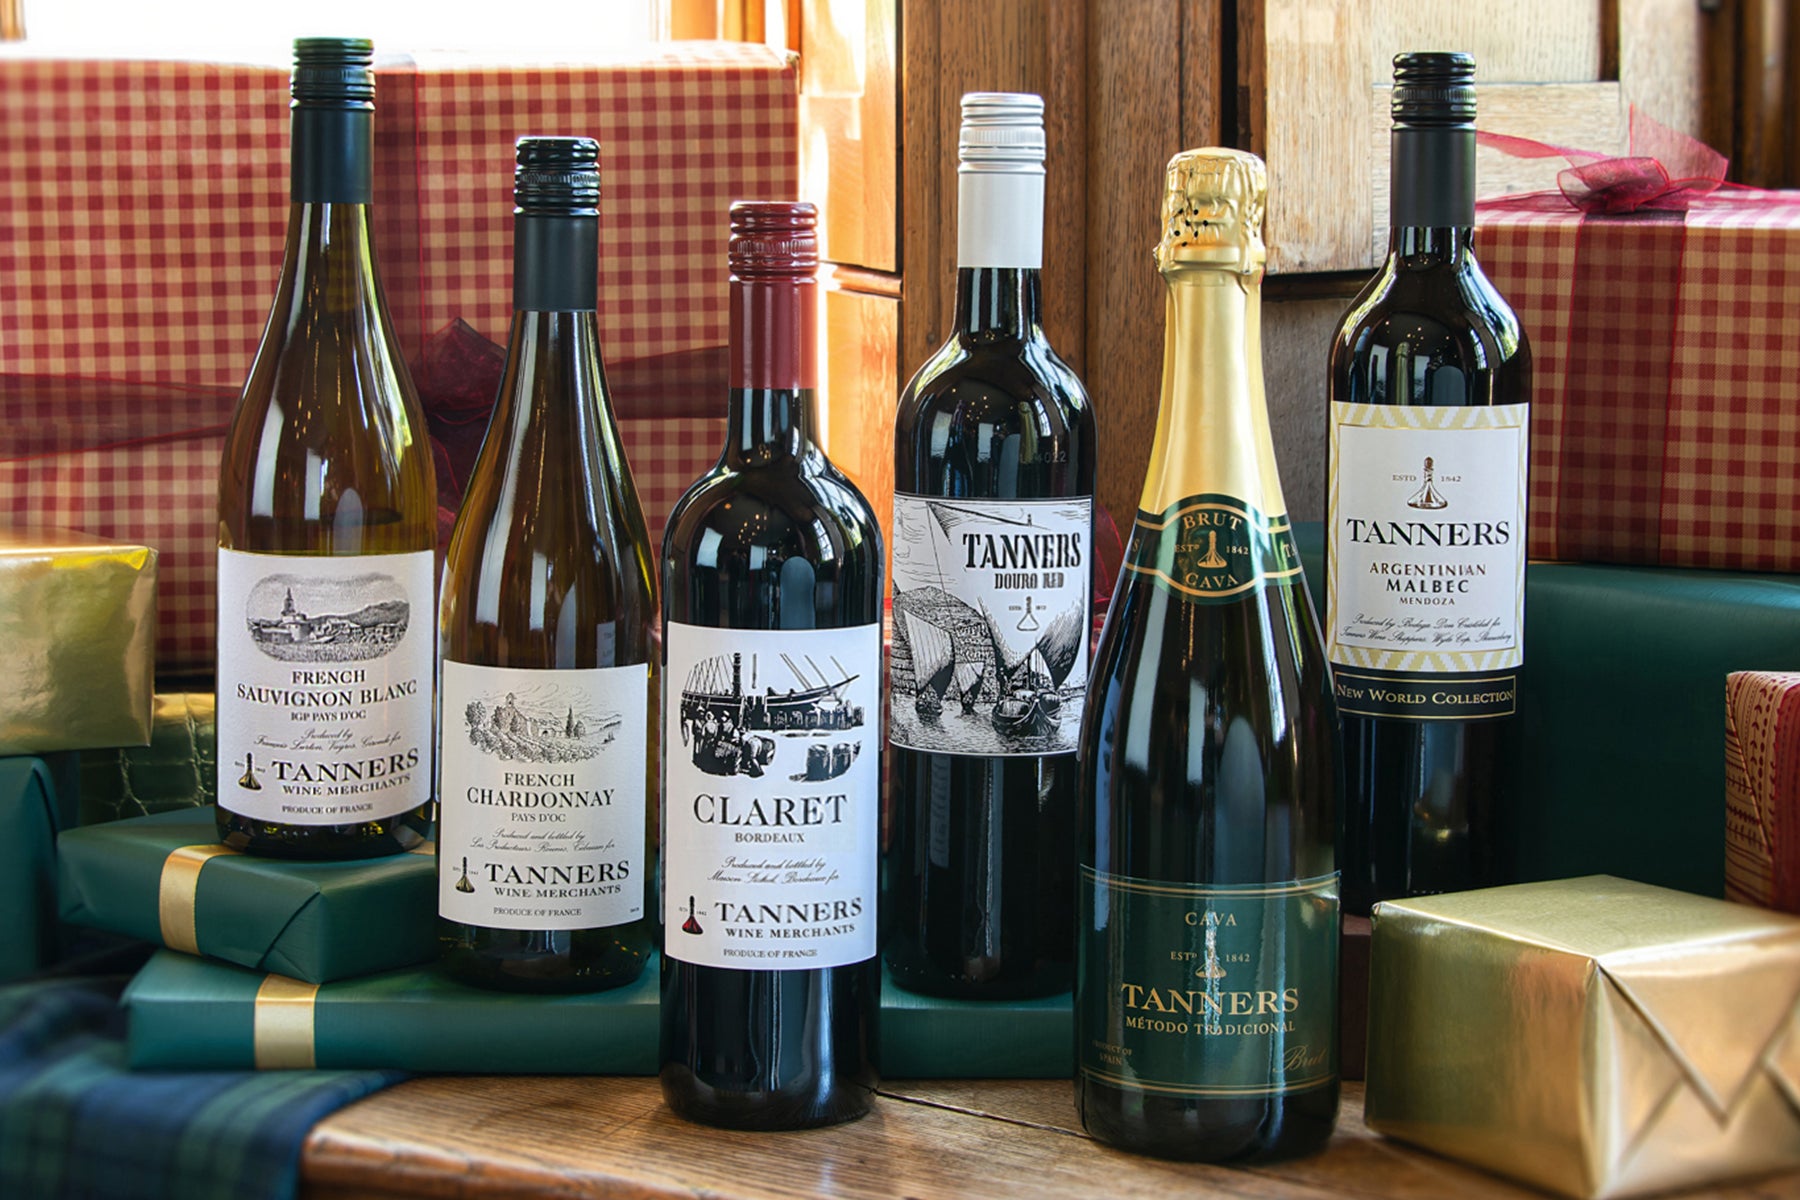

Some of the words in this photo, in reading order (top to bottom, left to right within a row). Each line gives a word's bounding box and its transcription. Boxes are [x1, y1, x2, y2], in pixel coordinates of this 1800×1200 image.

[1441, 475, 1462, 483] 1842
[1182, 512, 1242, 531] BRUT
[1346, 518, 1510, 547] TANNERS
[962, 532, 1081, 569] TANNERS
[1226, 545, 1249, 555] 1842
[1370, 562, 1486, 576] ARGENTINIAN
[994, 573, 1038, 590] DOURO
[1042, 572, 1064, 589] RED
[1185, 572, 1239, 589] CAVA
[1386, 578, 1469, 594] MALBEC
[1400, 597, 1455, 606] MENDOZA
[1352, 613, 1387, 626] Produced
[292, 670, 366, 685] FRENCH
[237, 683, 352, 707] SAUVIGNON
[360, 679, 418, 705] BLANC
[290, 711, 310, 722] IGP
[312, 712, 338, 722] PAYS
[300, 728, 344, 740] Produced
[271, 748, 419, 782] TANNERS
[282, 784, 322, 796] WINE
[328, 774, 411, 796] MERCHANTS
[504, 772, 575, 787] FRENCH
[466, 786, 615, 808] CHARDONNAY
[282, 804, 322, 814] PRODUCE
[325, 805, 338, 814] OF
[340, 803, 374, 814] FRANCE
[693, 794, 848, 826] CLARET
[511, 812, 536, 822] PAYS
[492, 827, 531, 839] Produced
[530, 831, 550, 840] and
[735, 832, 805, 844] BORDEAUX
[720, 856, 767, 868] Produced
[765, 859, 788, 869] and
[785, 859, 817, 869] bottled
[815, 858, 826, 872] by
[484, 860, 630, 884] TANNERS
[494, 887, 532, 898] WINE
[536, 884, 622, 898] MERCHANTS
[493, 906, 532, 916] PRODUCE
[534, 908, 546, 916] OF
[548, 908, 582, 916] FRANCE
[714, 897, 862, 924] TANNERS
[1184, 912, 1238, 927] CAVA
[726, 928, 764, 938] WINE
[770, 924, 855, 938] MERCHANTS
[724, 948, 766, 958] PRODUCE
[767, 949, 780, 958] OF
[782, 948, 818, 958] FRANCE
[1225, 953, 1250, 963] 1842
[1121, 983, 1299, 1016] TANNERS
[1126, 1016, 1188, 1034] MÉTODO
[1194, 1021, 1296, 1036] TRADICIONAL
